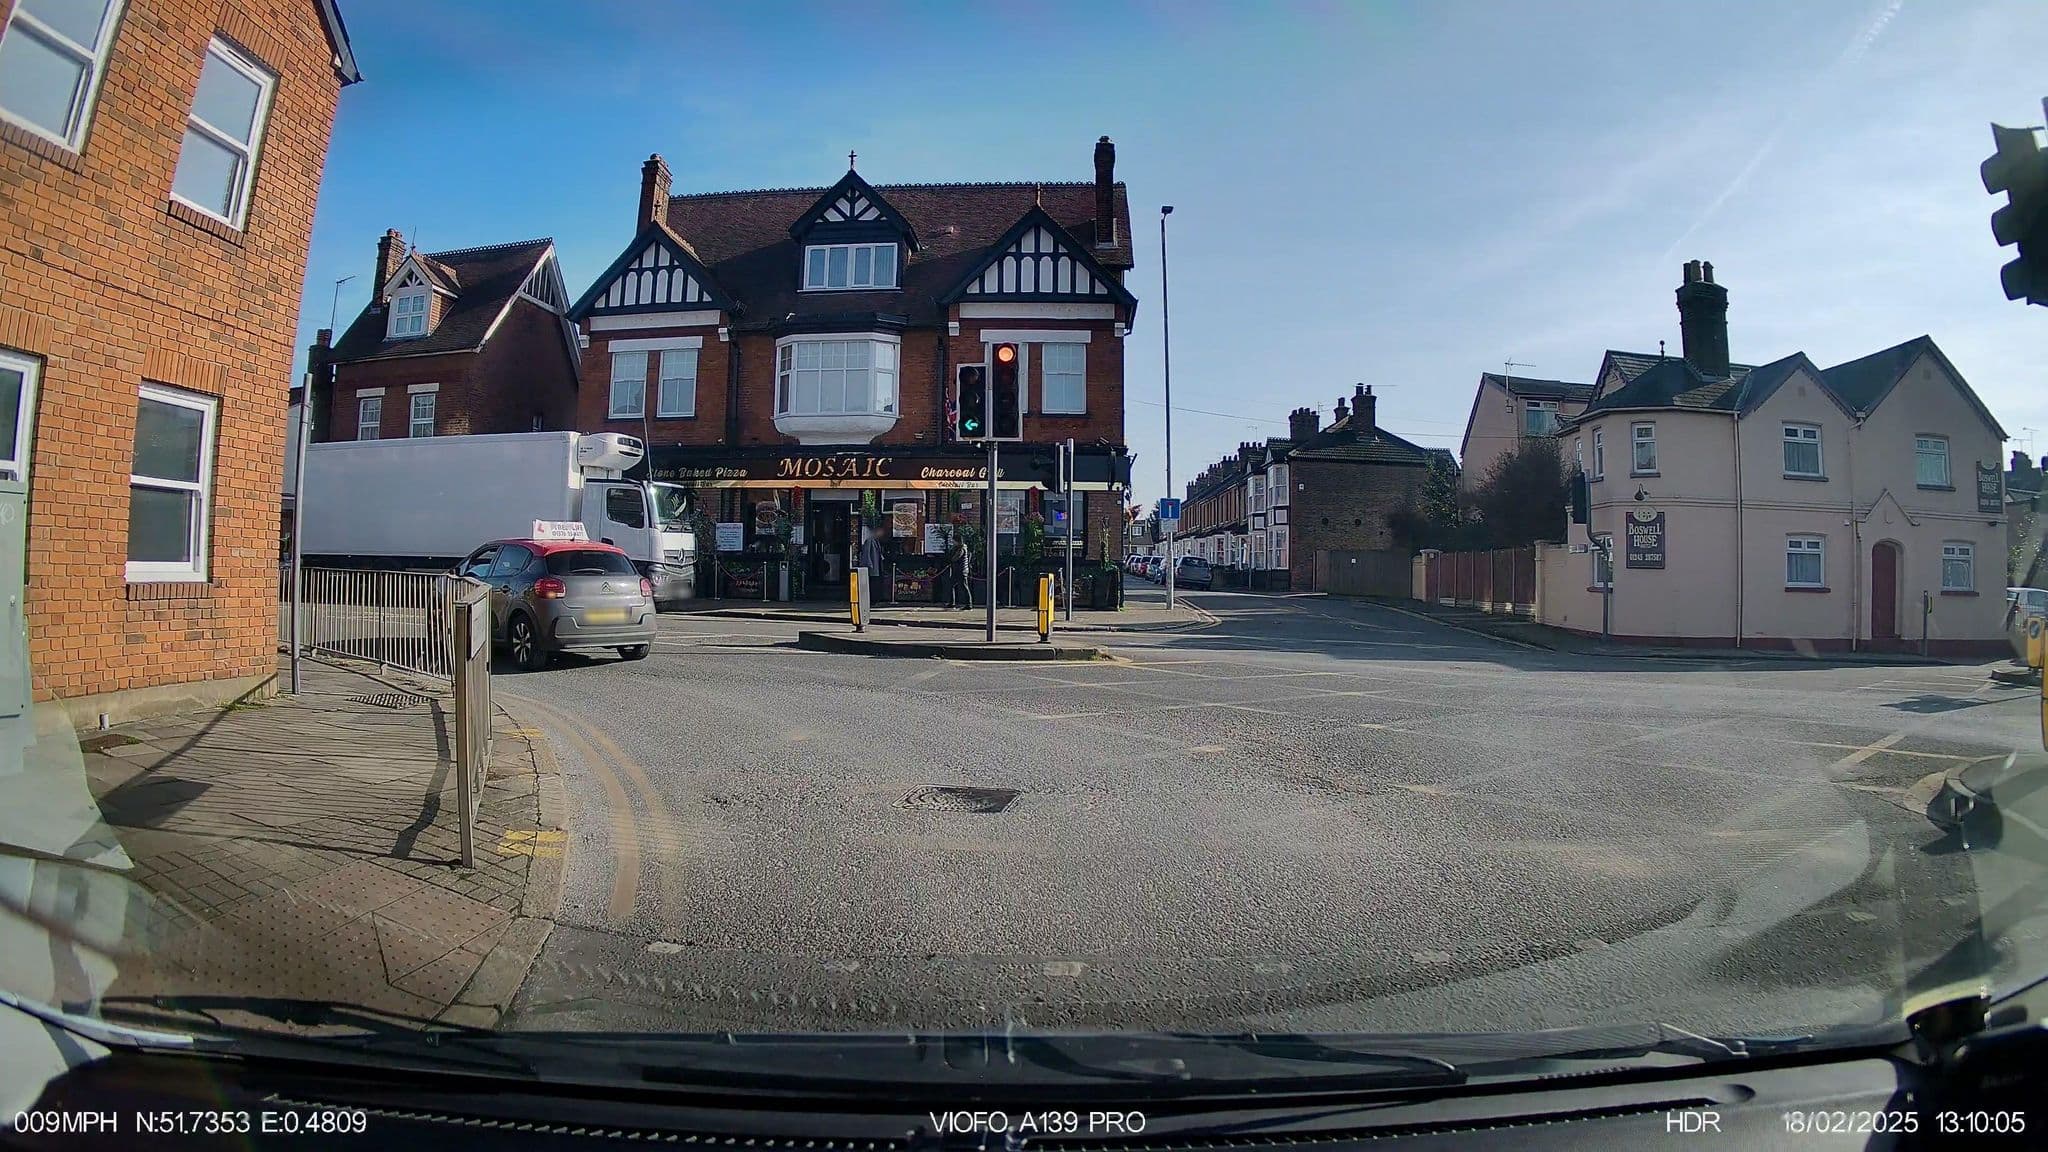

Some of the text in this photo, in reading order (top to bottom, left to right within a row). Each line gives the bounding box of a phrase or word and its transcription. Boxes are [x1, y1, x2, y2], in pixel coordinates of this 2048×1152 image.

[678, 467, 712, 478] Baked
[715, 466, 748, 478] Pizza
[777, 457, 893, 477] MOSAIC
[920, 466, 975, 479] Charcoal
[1628, 523, 1662, 535] BOSWELL
[1633, 534, 1658, 547] HOUSE
